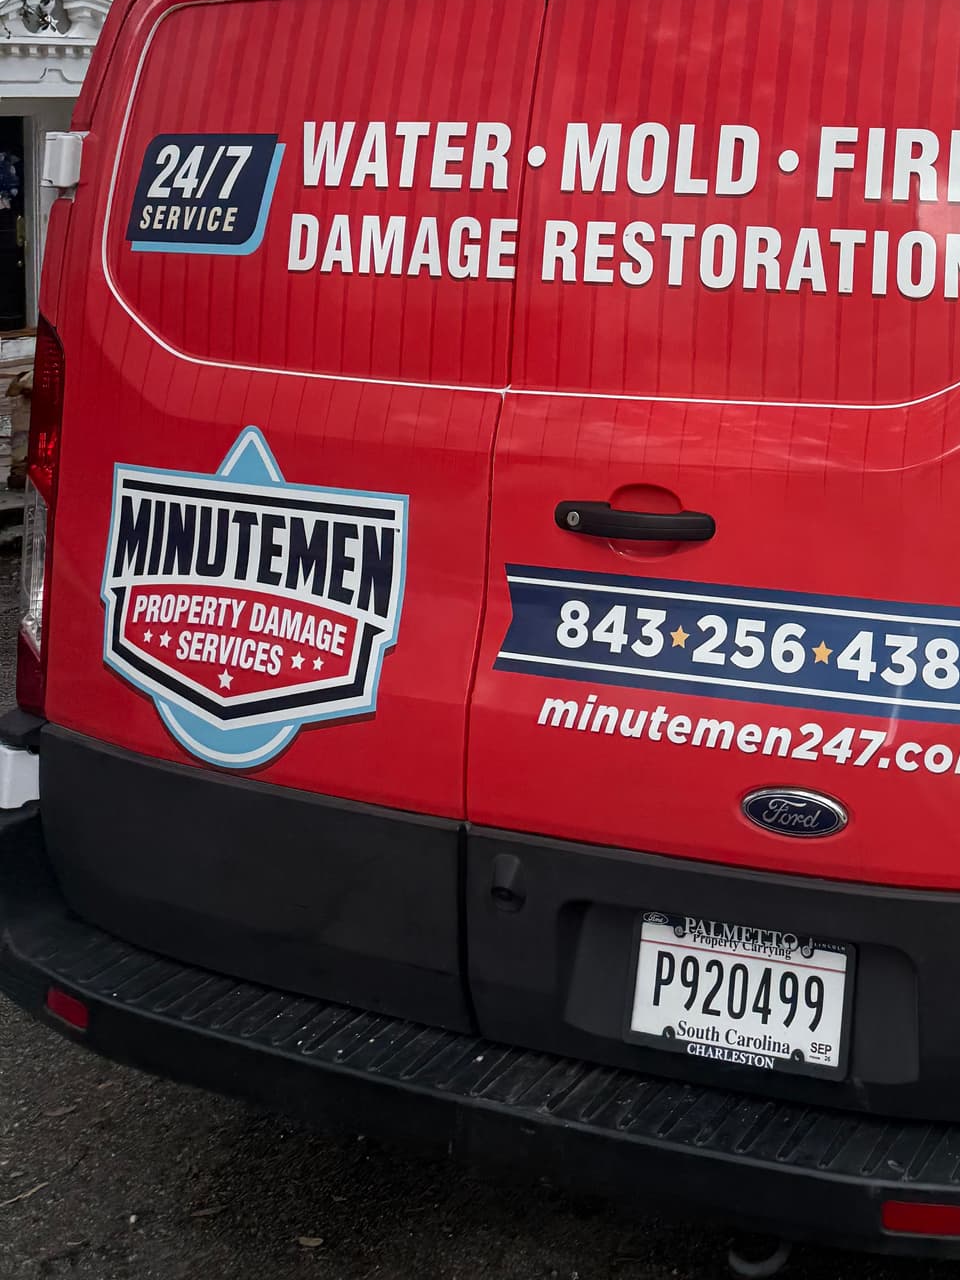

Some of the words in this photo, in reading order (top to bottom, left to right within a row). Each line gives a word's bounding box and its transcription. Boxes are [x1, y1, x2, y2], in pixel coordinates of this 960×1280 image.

[146, 144, 253, 200] 24/7
[302, 121, 513, 191] WATER
[559, 122, 761, 196] MOLD
[139, 204, 239, 233] SERVICE
[287, 213, 520, 281] DAMAGE
[112, 495, 396, 619] MINUTEMEN
[132, 593, 247, 629] PROPERTY
[248, 602, 348, 657] DAMAGE
[555, 599, 668, 659] 843
[691, 614, 807, 674] 256
[175, 630, 284, 677] SERVICES
[761, 798, 822, 828] Ford
[692, 933, 740, 952] Property
[742, 940, 792, 961] Carrying
[652, 950, 825, 1033] P920499
[676, 1019, 720, 1043] South
[725, 1028, 791, 1055] Carolina
[686, 1042, 776, 1070] CHARLESTON
[810, 1041, 833, 1056] SEP
